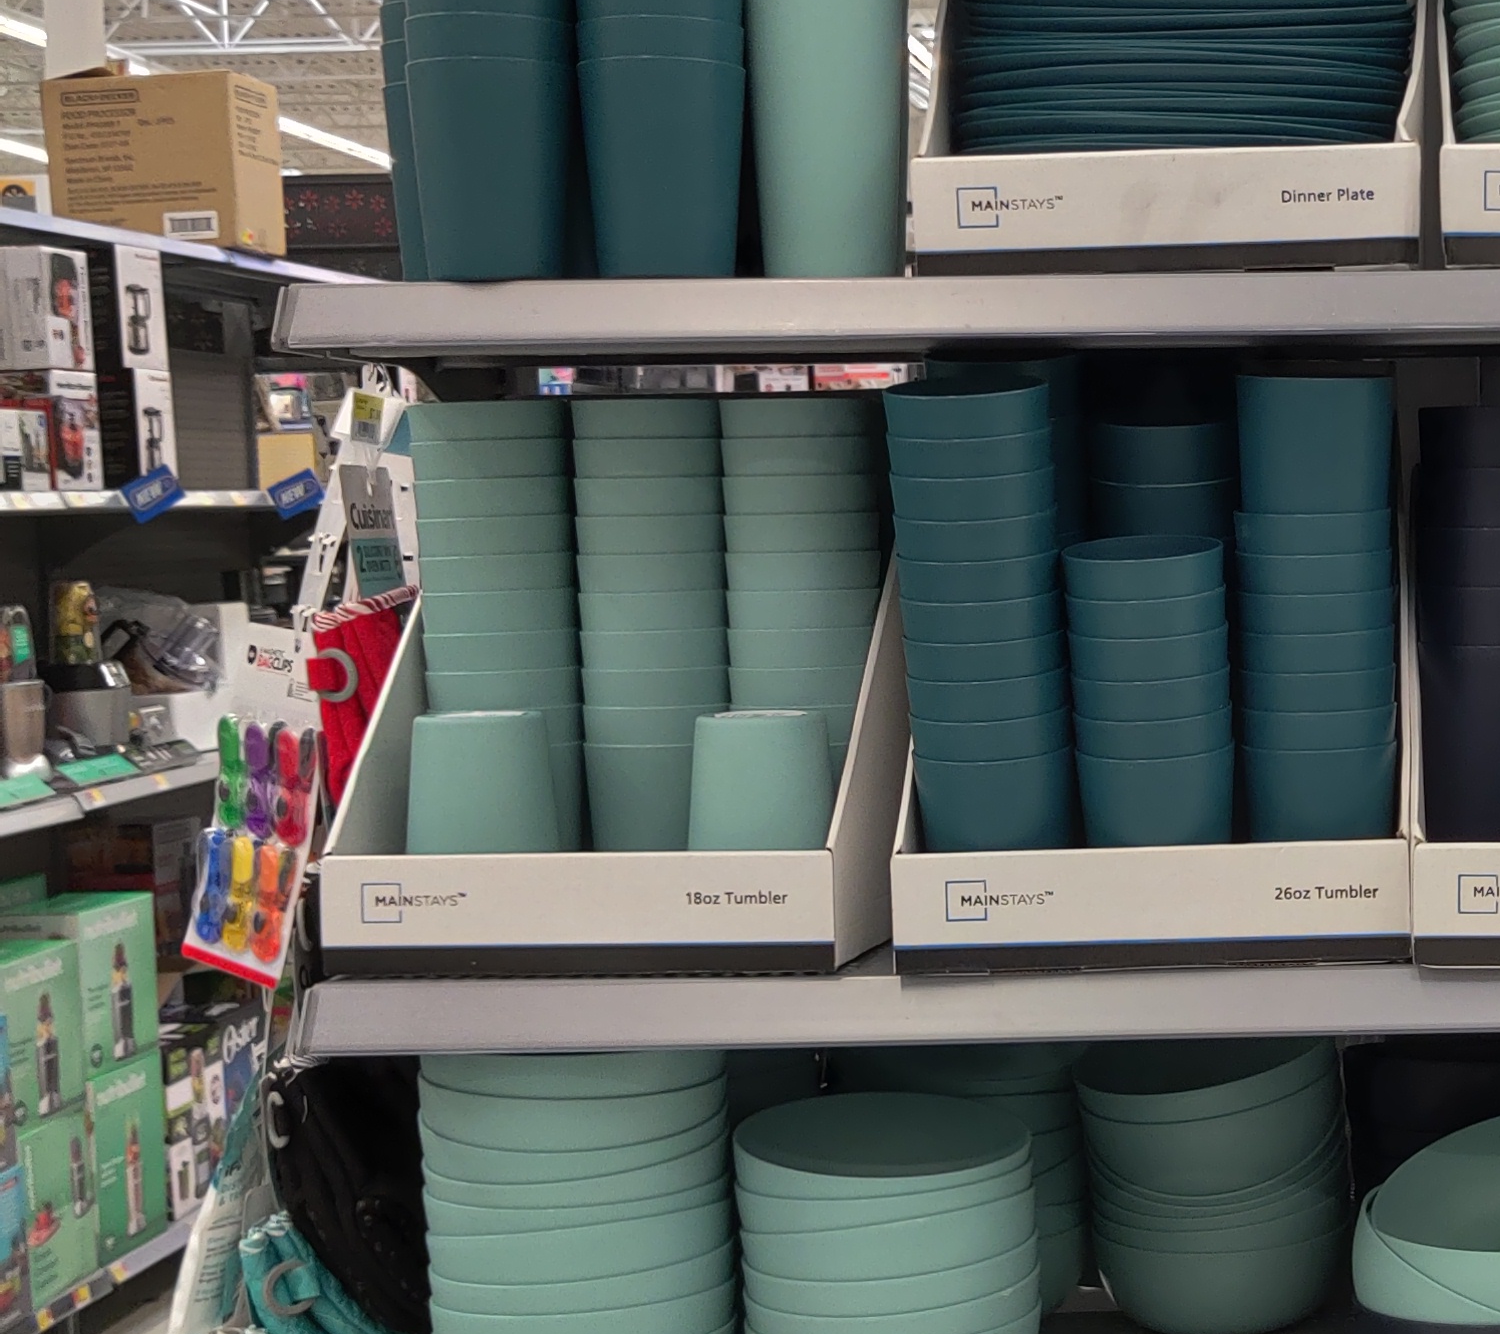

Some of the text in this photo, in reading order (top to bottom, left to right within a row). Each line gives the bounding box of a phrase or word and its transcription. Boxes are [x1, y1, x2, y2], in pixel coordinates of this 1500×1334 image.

[1281, 187, 1375, 204] Dinner Plate
[686, 889, 788, 906] 18oz Tumbler
[1275, 884, 1379, 901] 26oz Tumbler
